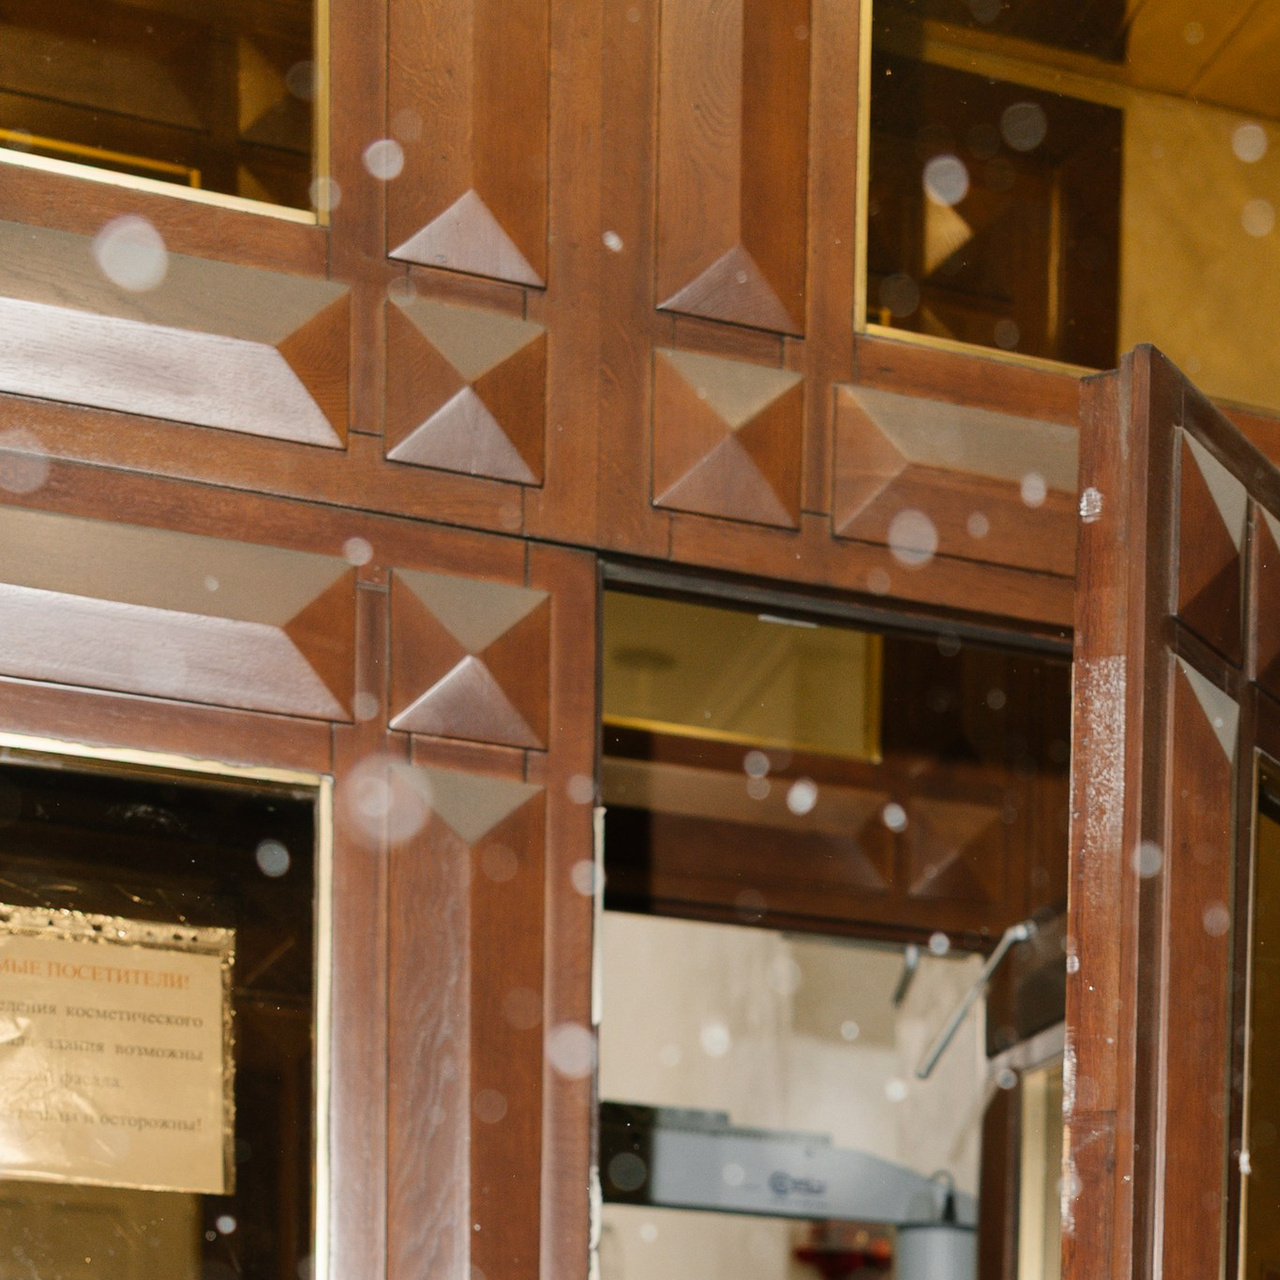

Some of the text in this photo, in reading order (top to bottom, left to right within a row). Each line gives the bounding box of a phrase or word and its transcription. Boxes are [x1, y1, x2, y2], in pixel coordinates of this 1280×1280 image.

[47, 961, 190, 989] ПОСЕТИТЕЛИ!
[66, 1006, 204, 1027] косметического
[115, 1044, 204, 1062] возможны
[99, 1114, 201, 1133] осторожны!
